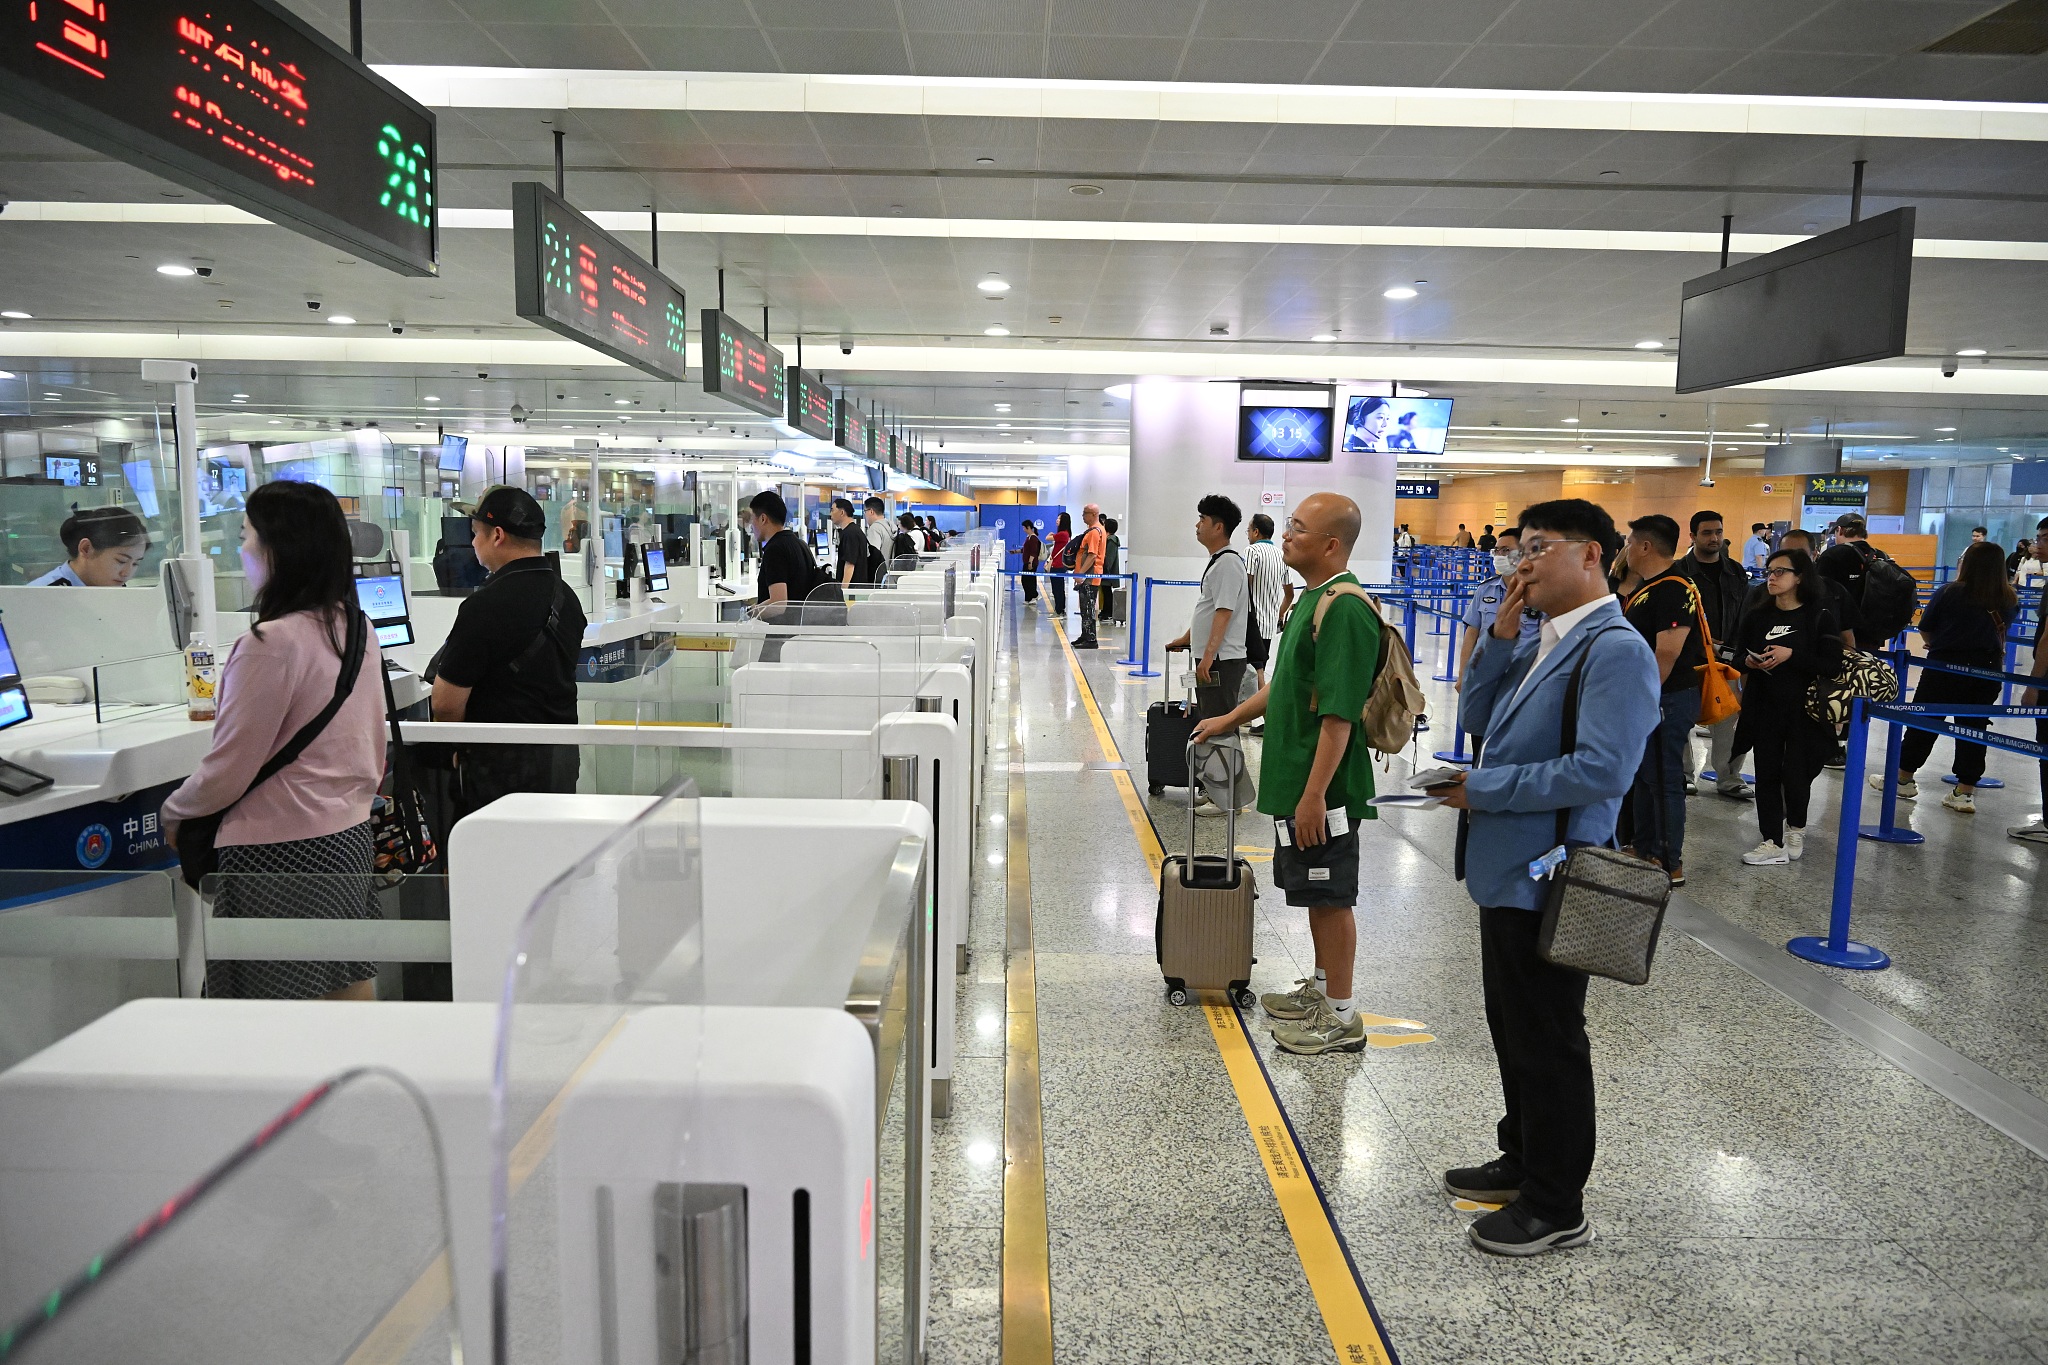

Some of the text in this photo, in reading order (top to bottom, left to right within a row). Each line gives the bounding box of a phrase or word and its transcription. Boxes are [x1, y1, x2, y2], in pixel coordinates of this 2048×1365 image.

[86, 461, 97, 474] 16
[211, 469, 219, 479] 17
[1771, 625, 1792, 634] NIKE
[1987, 734, 2005, 744] CHINA
[2005, 738, 2044, 753] IMMIGRATION
[128, 838, 159, 855] CHINA
